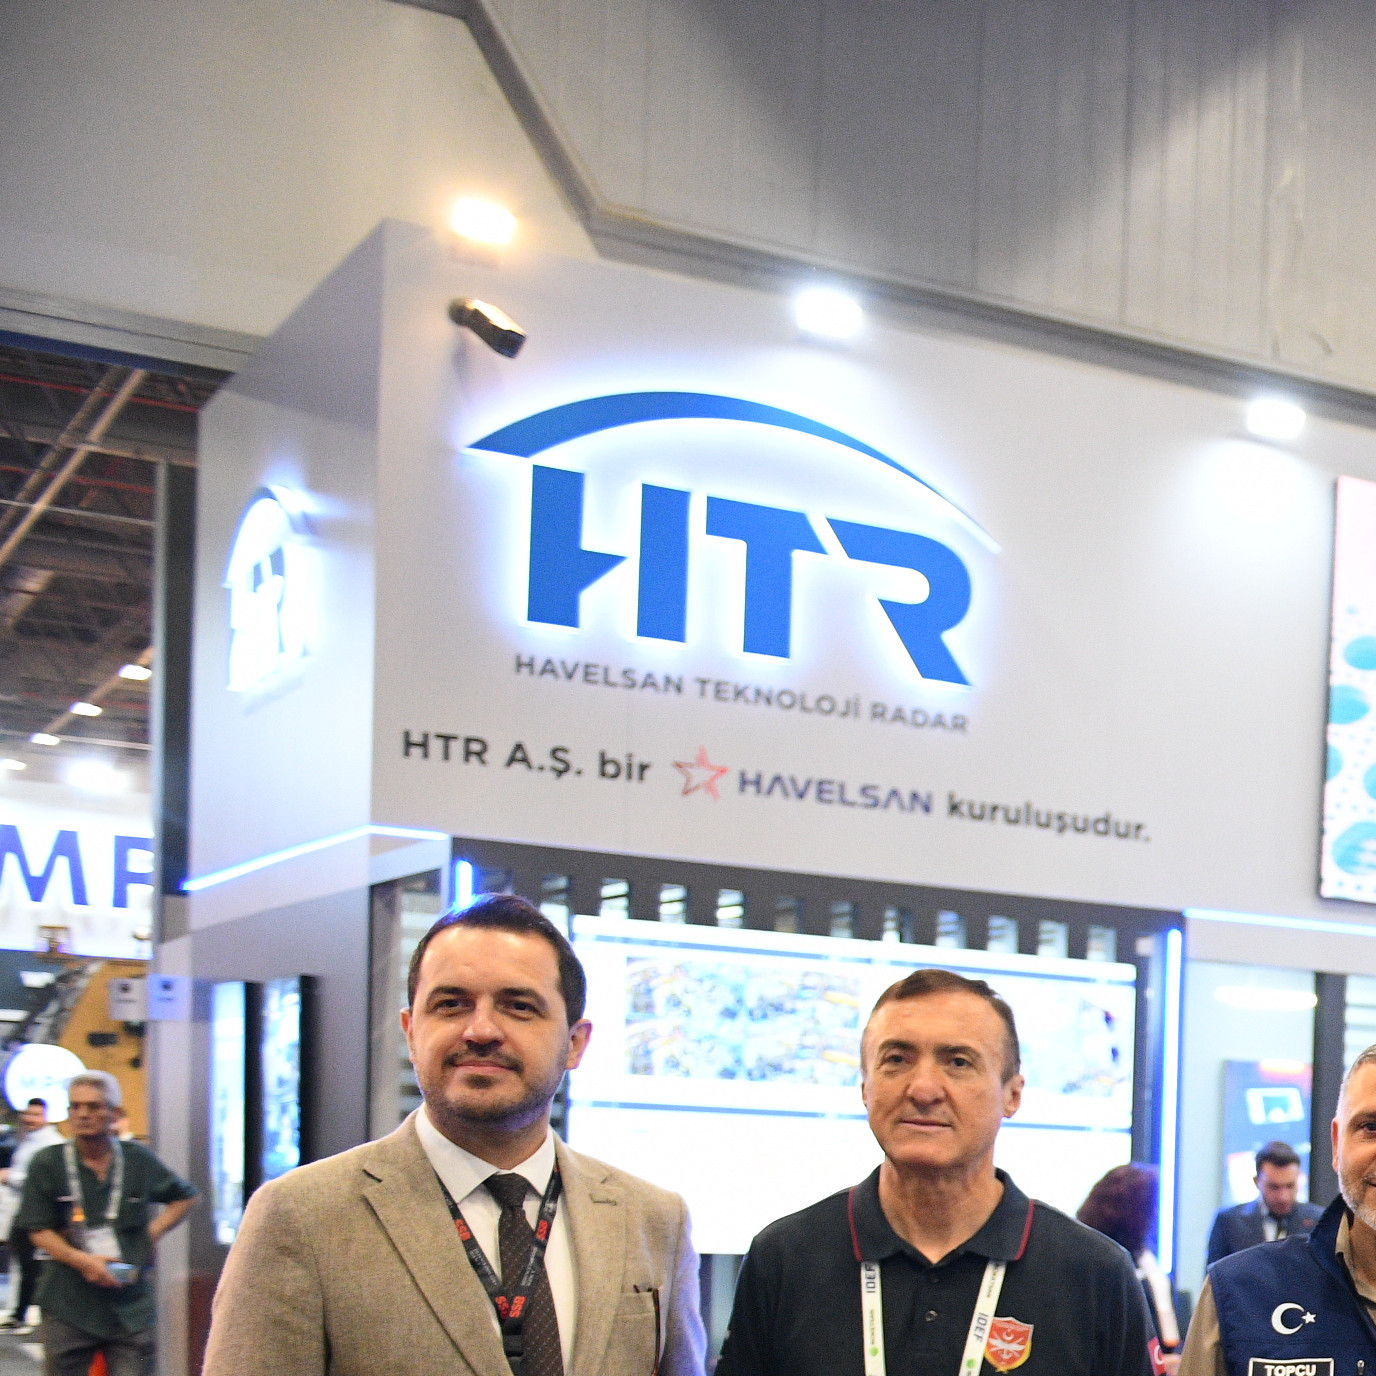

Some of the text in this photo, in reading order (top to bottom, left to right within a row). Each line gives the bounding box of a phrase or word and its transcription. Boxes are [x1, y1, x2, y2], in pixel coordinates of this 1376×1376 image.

[527, 464, 973, 686] HTR
[514, 653, 968, 733] HAVELSAN TEKNOLOJİ RADAR
[402, 729, 1151, 842] HTR A.Ş. bir HAVELSAN kuruluşudur.
[972, 1312, 989, 1344] IDEF
